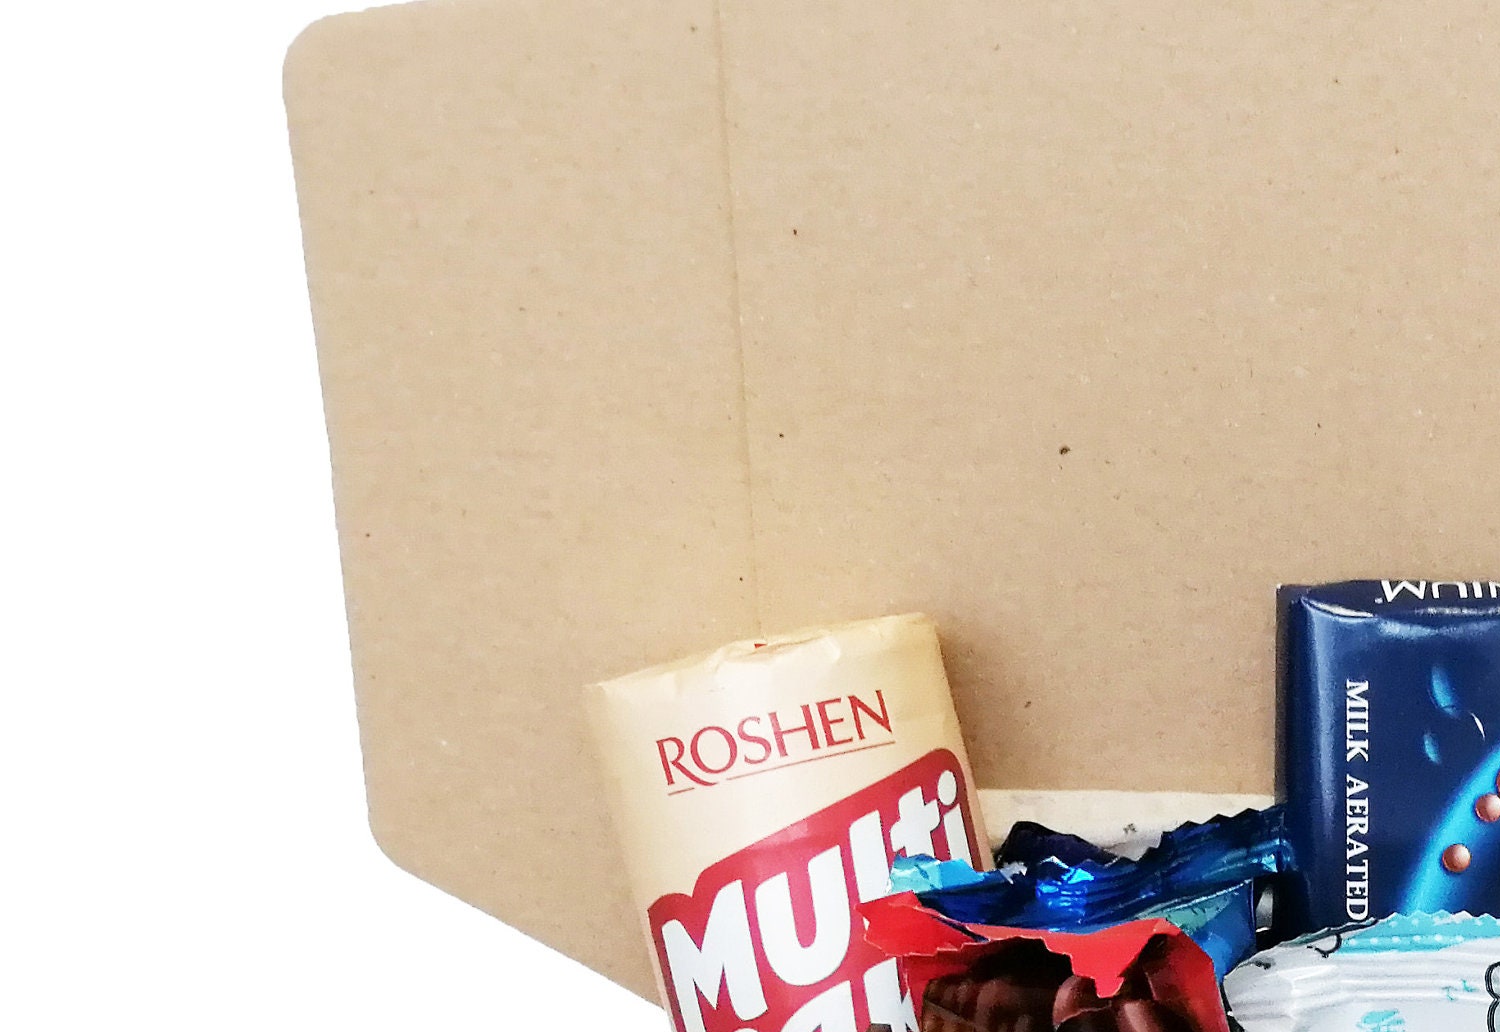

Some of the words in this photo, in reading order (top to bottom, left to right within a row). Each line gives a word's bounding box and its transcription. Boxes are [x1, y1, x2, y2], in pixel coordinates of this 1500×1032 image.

[655, 689, 893, 787] ROSHEN
[1346, 679, 1370, 762] MILK
[1346, 773, 1370, 921] AERATED
